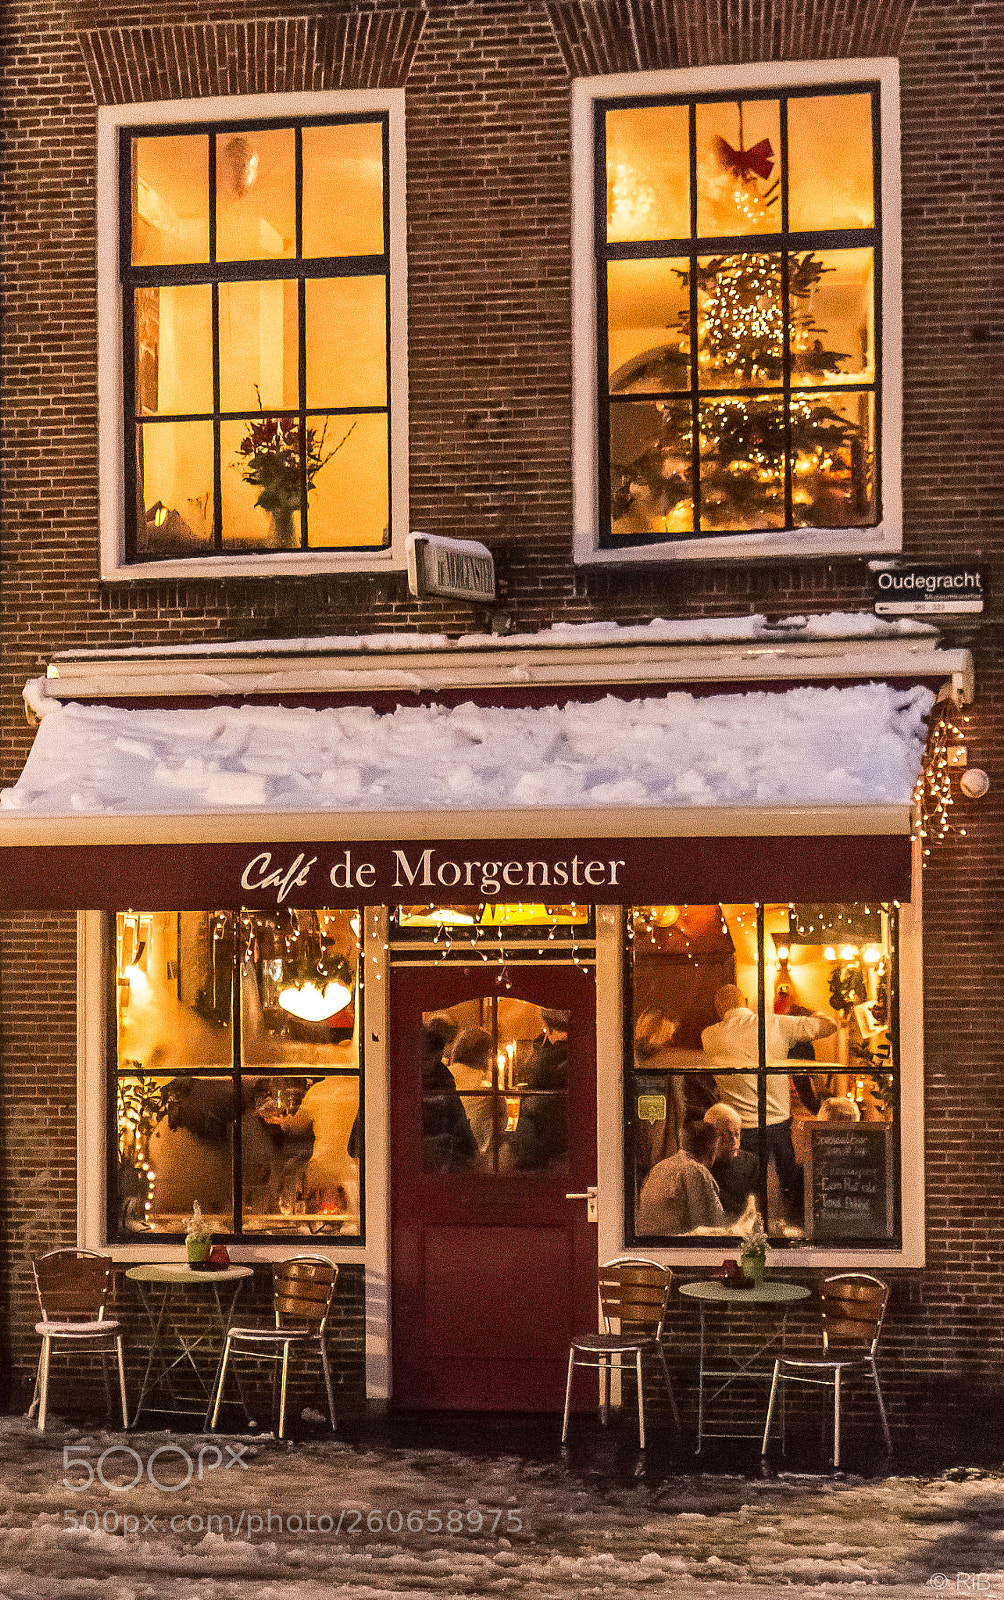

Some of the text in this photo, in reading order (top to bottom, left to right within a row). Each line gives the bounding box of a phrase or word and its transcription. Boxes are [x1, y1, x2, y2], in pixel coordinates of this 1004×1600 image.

[878, 572, 981, 592] Oudegracht
[240, 849, 625, 904] Café de Morgenster
